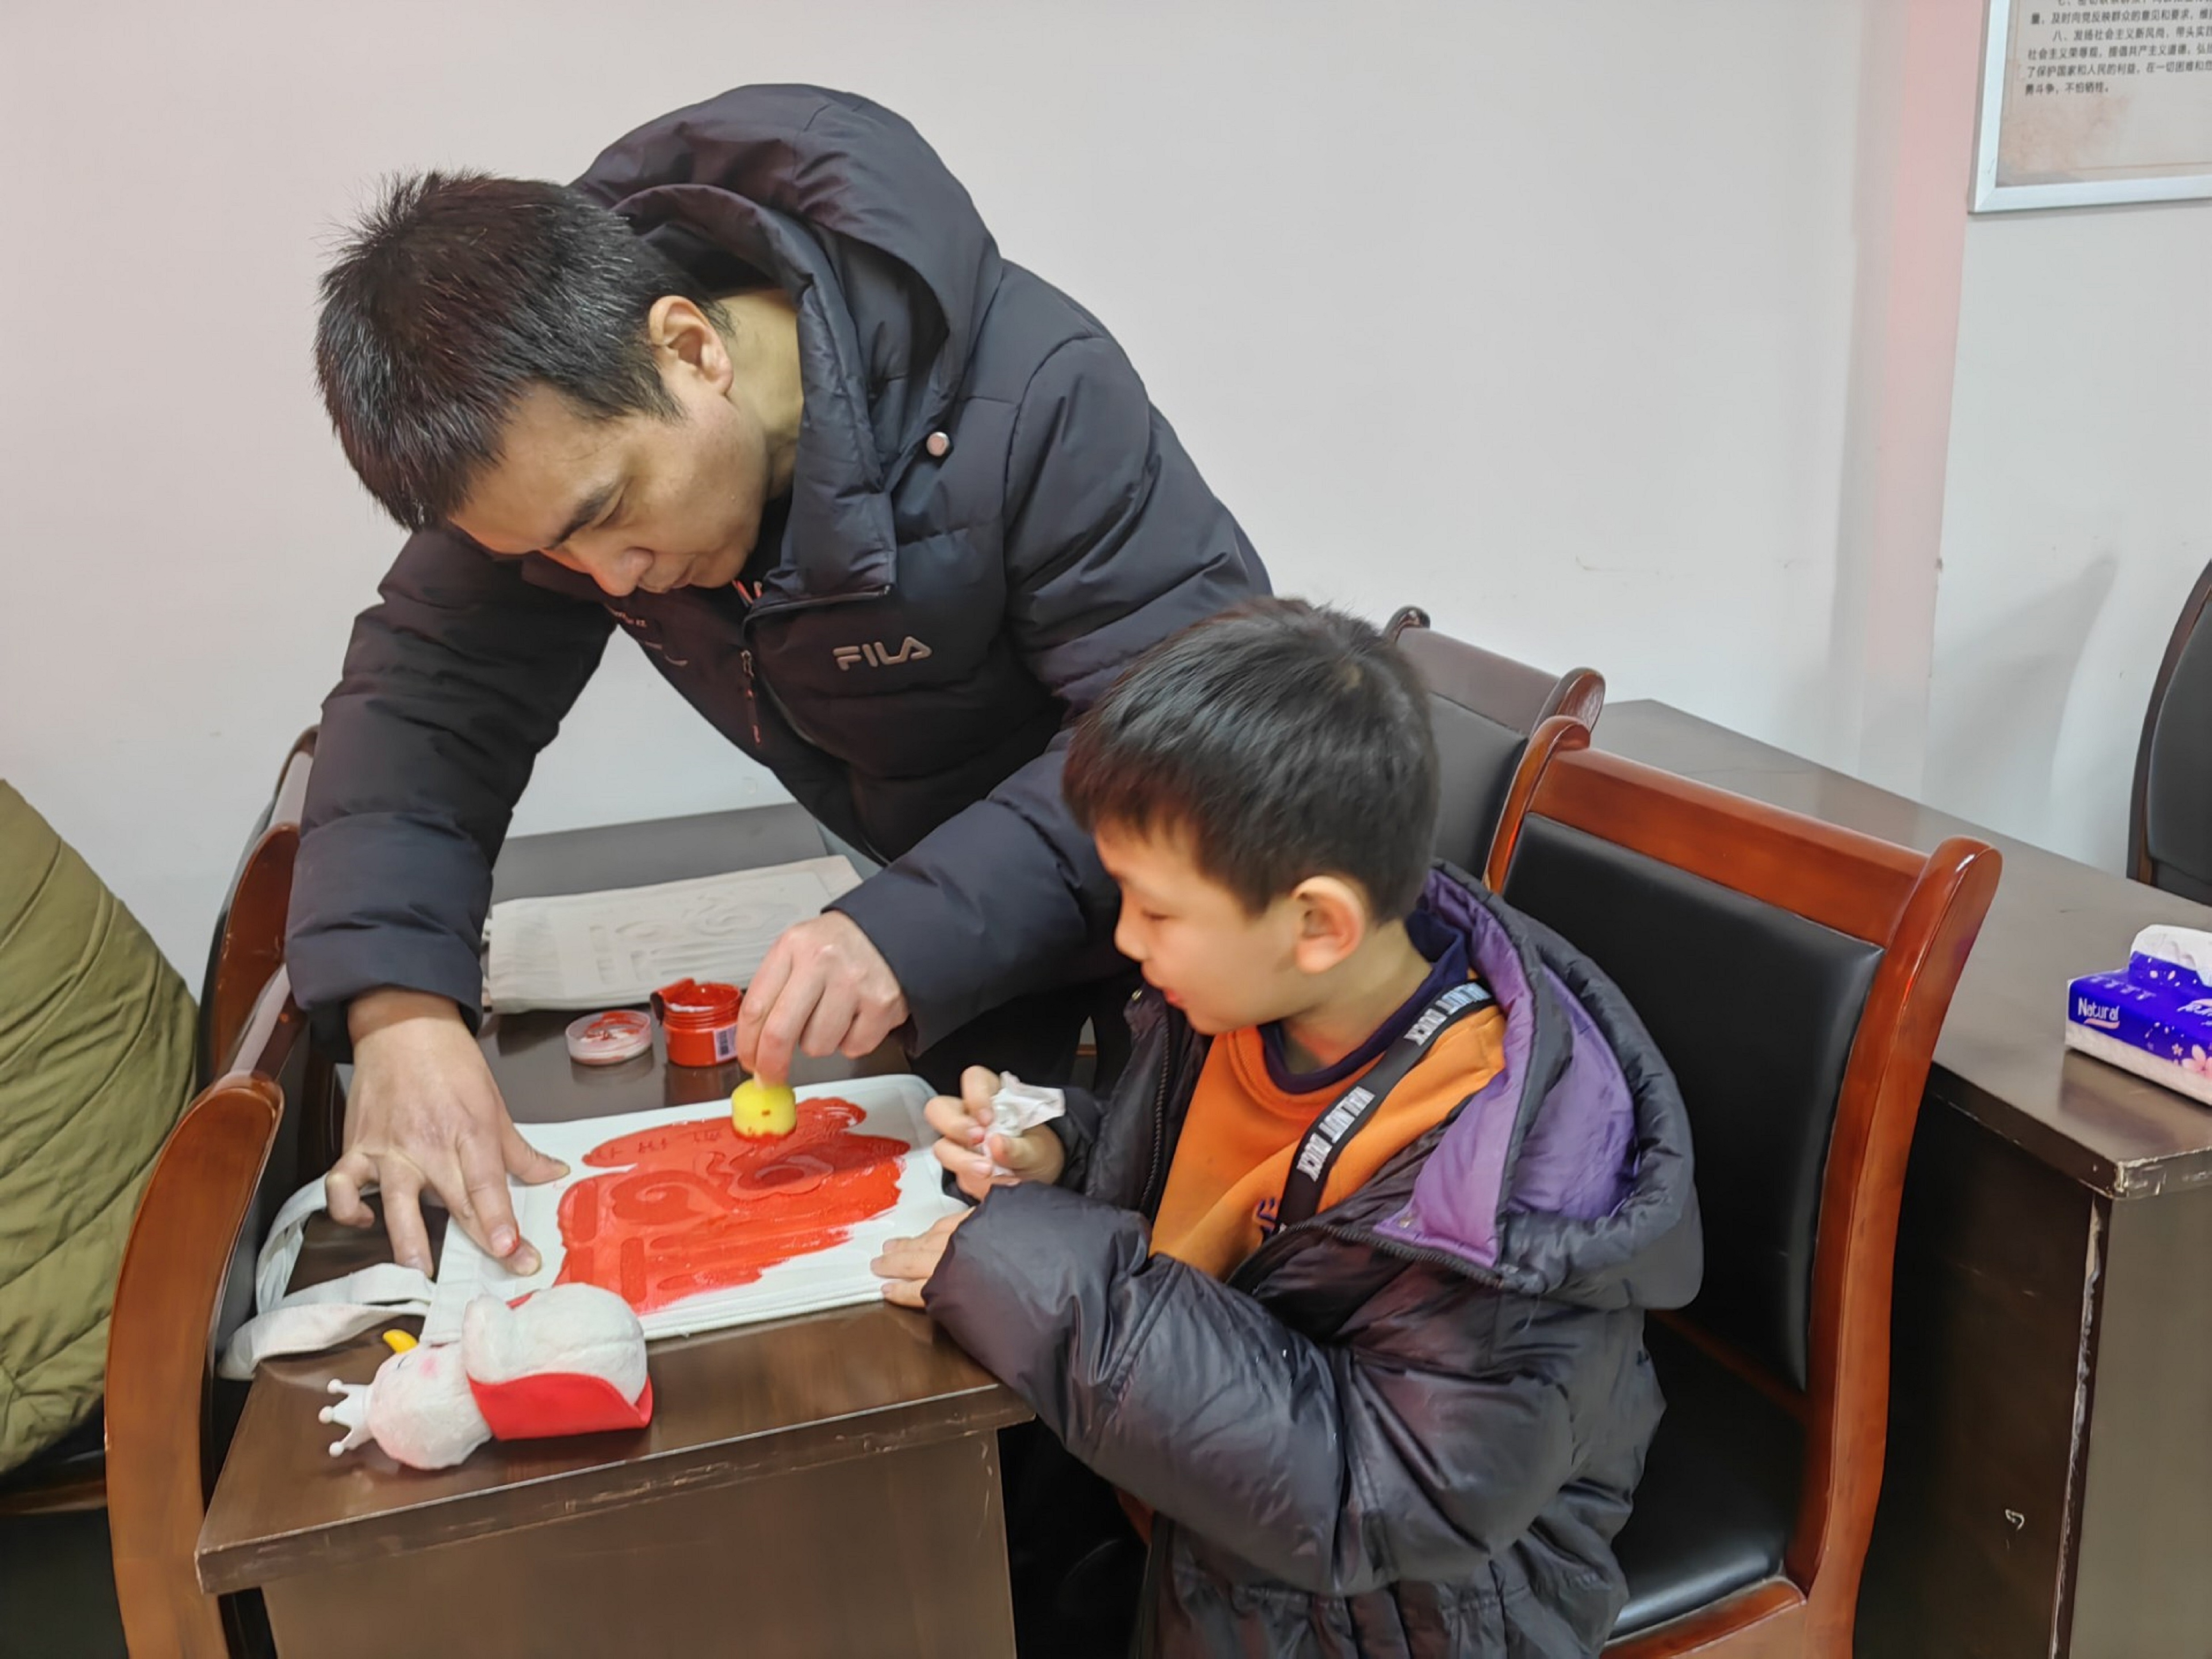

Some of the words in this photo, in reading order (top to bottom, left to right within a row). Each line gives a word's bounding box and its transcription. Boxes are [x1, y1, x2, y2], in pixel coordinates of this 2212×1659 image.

[833, 636, 932, 670] FILA
[1403, 1008, 1447, 1046] DUCK
[2078, 997, 2120, 1021] Natural
[1318, 1086, 1376, 1143] WALNUT
[1297, 1132, 1333, 1182] DUCK
